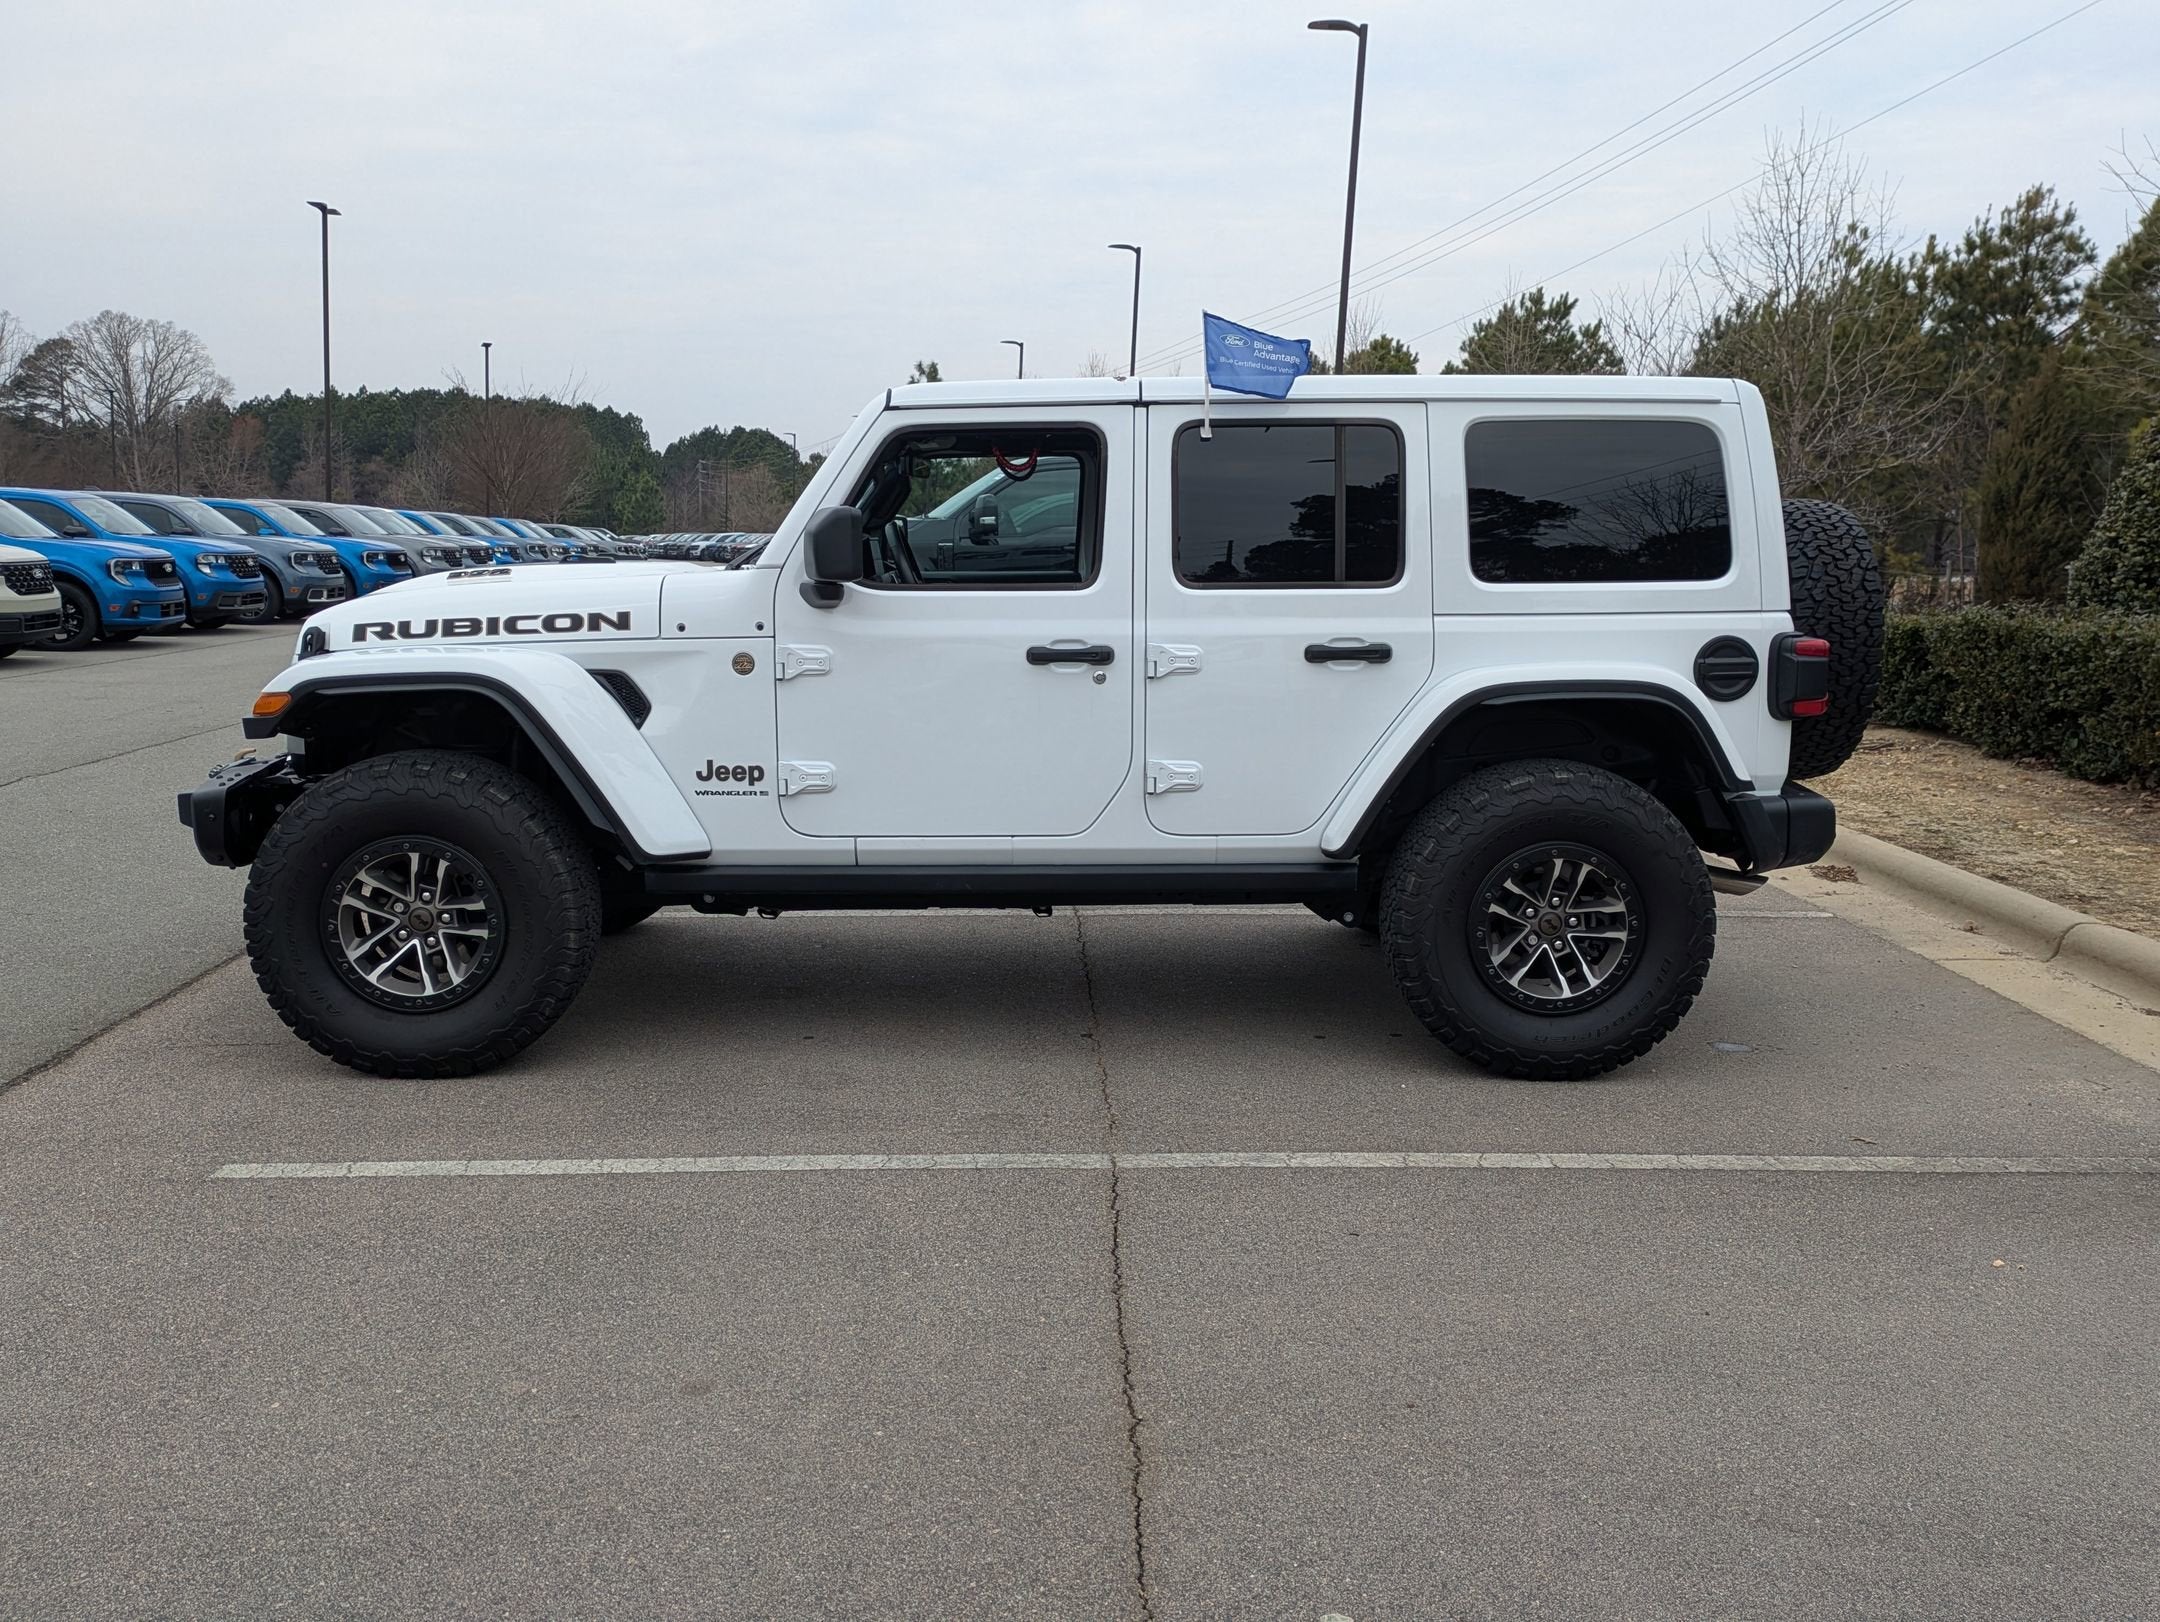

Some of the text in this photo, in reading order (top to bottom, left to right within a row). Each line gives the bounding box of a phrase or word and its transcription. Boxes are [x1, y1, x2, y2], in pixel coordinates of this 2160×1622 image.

[1254, 341, 1273, 351] Blue
[1254, 350, 1300, 364] Advantage
[1234, 359, 1260, 369] Certified
[1262, 363, 1276, 372] Used
[1278, 366, 1294, 374] Vehic
[351, 611, 632, 643] RUBICON
[695, 759, 765, 787] Jeep
